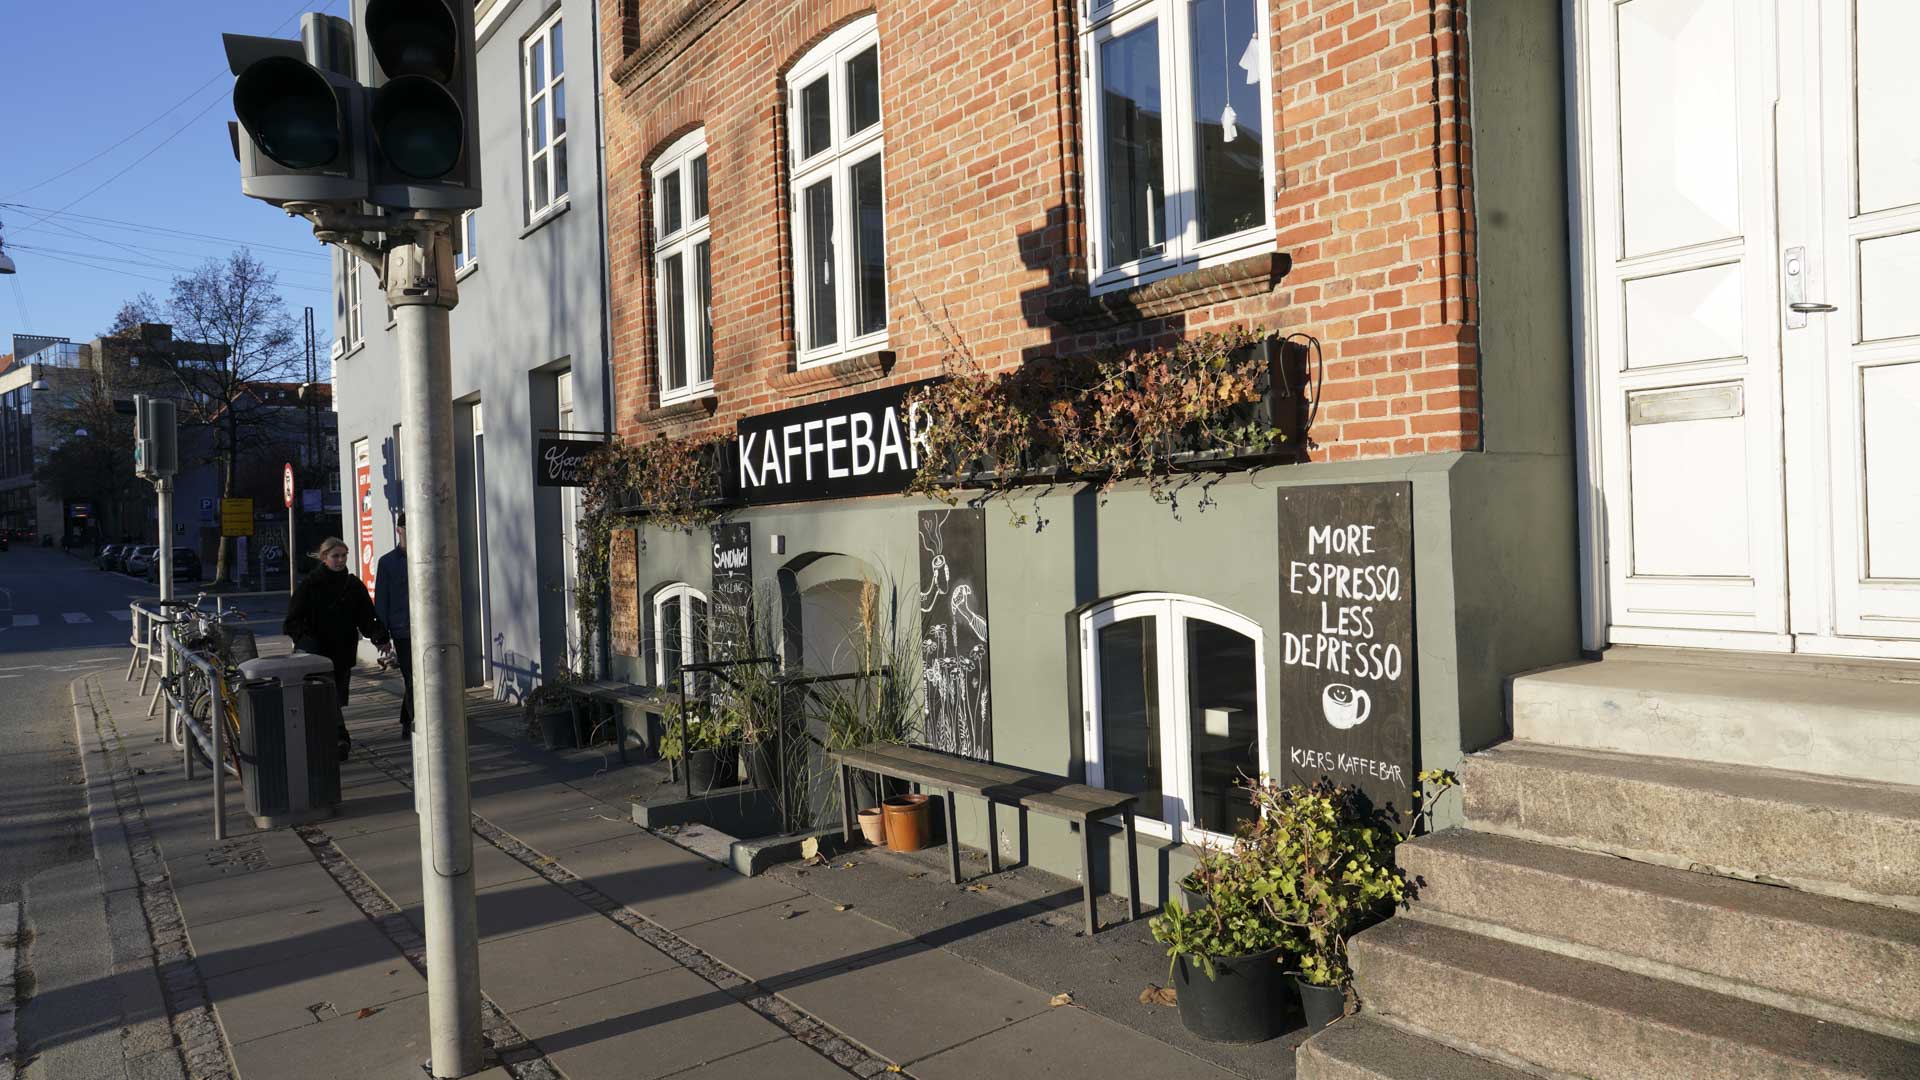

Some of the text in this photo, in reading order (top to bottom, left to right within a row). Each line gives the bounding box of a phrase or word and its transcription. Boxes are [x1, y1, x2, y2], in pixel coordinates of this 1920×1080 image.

[739, 400, 934, 489] KAFFEBAR
[1308, 524, 1376, 557] MORE
[1321, 601, 1374, 639] LESS
[1283, 632, 1402, 681] DEPRESSO
[1291, 746, 1405, 788] KJÆRS KAFFEBAR
